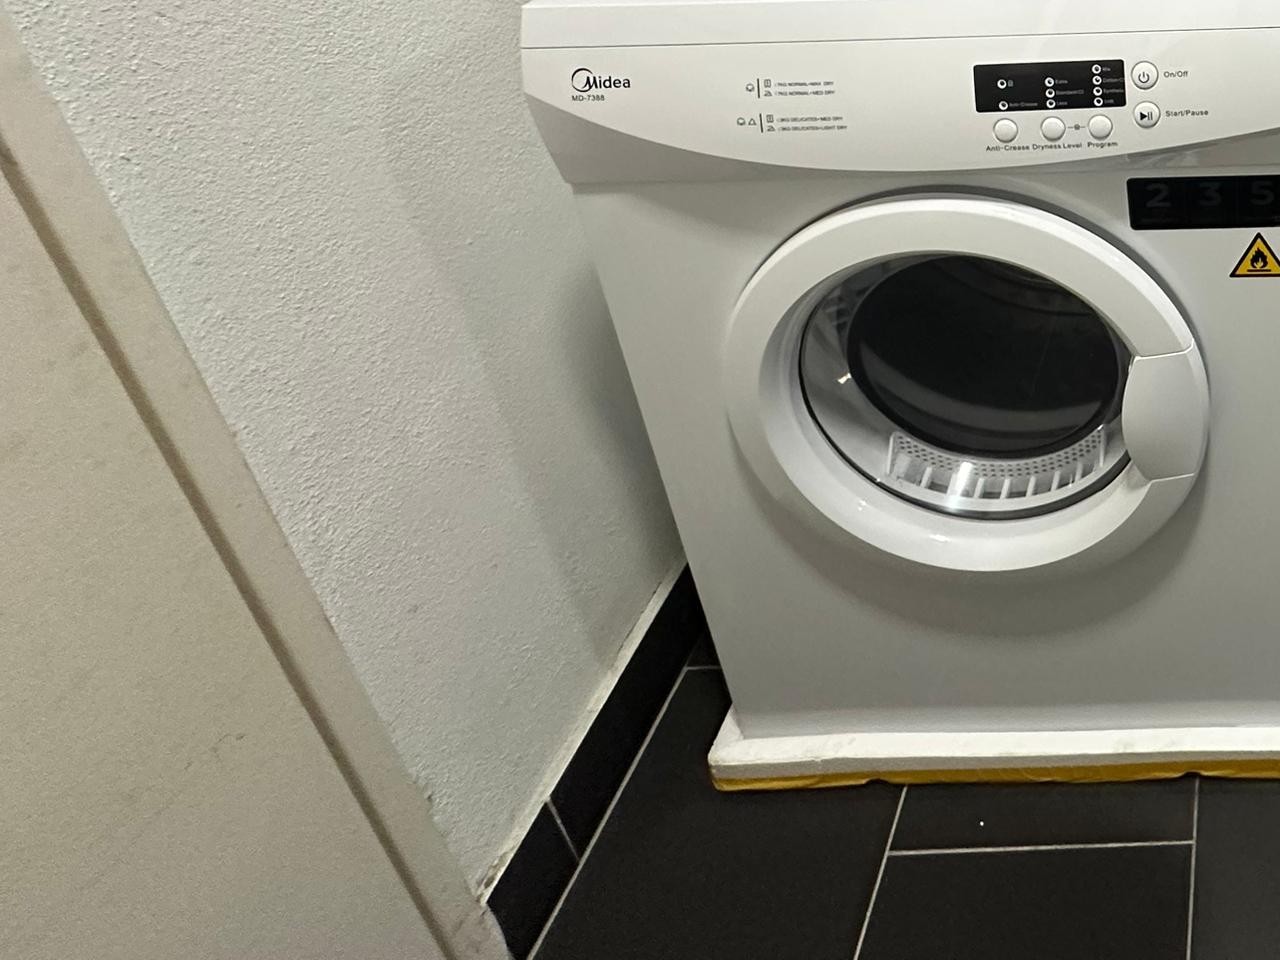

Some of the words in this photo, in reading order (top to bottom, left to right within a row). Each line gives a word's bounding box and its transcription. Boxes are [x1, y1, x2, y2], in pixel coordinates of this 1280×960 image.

[1163, 70, 1188, 78] On/Off
[571, 67, 631, 93] Midea
[1165, 109, 1209, 117] Start/Pause
[986, 144, 1030, 152] Anti-Crease
[1032, 143, 1061, 151] Dryness
[1087, 141, 1118, 149] Program
[1145, 183, 1172, 208] 2
[1199, 182, 1224, 208] 3
[1249, 179, 1276, 206] 5
